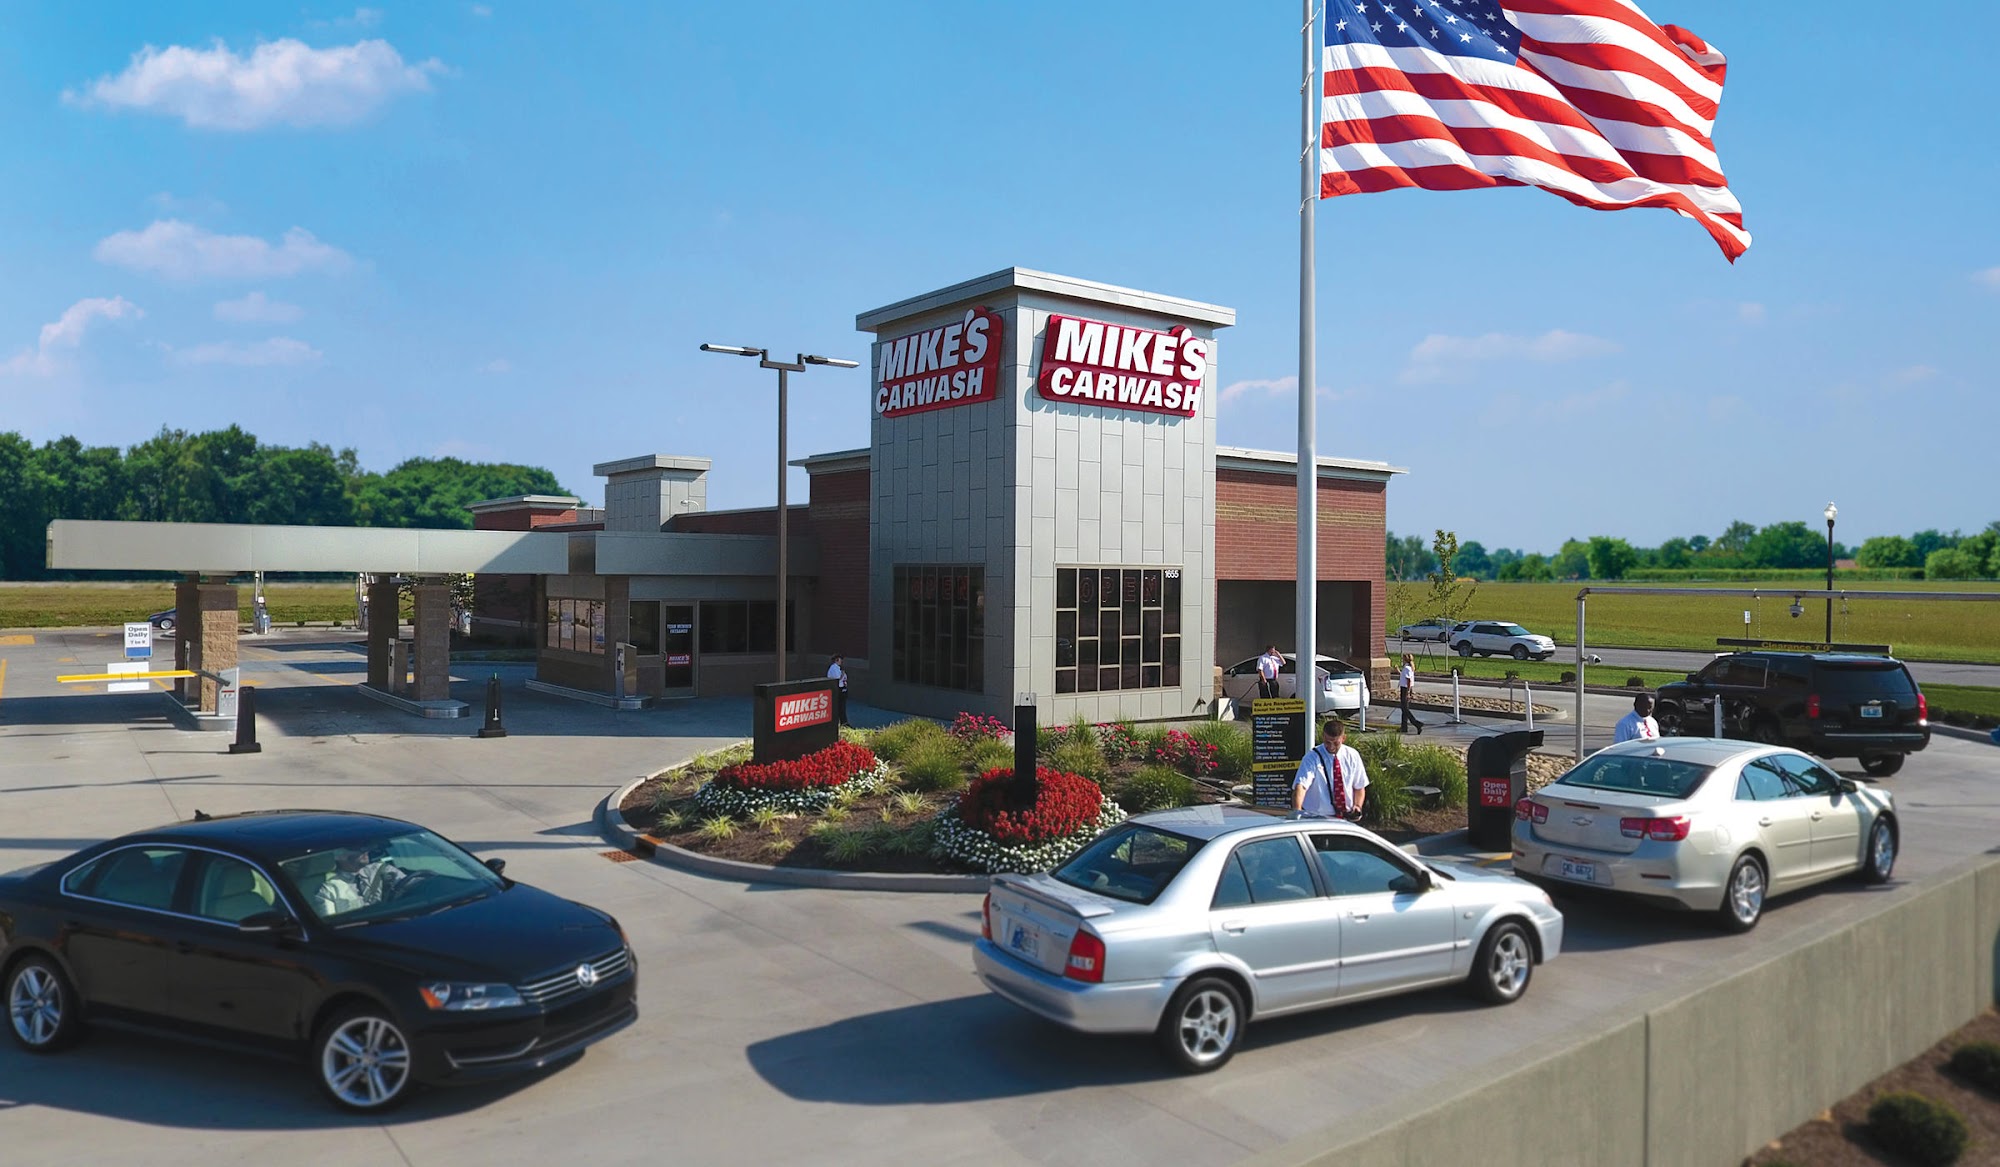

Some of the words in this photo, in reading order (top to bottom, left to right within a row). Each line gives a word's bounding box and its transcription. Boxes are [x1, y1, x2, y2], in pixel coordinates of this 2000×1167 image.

[877, 308, 990, 383] MIKE'S
[1054, 318, 1209, 381] MIKE'S
[875, 367, 984, 414] CARWASH
[1051, 366, 1200, 412] CARWASH
[1080, 577, 1157, 603] OPEN
[1761, 641, 1812, 651] Clearance
[780, 693, 829, 716] MIKE'S
[779, 709, 827, 726] CARWASH
[1483, 781, 1507, 790] Open
[1483, 787, 1507, 796] Daily
